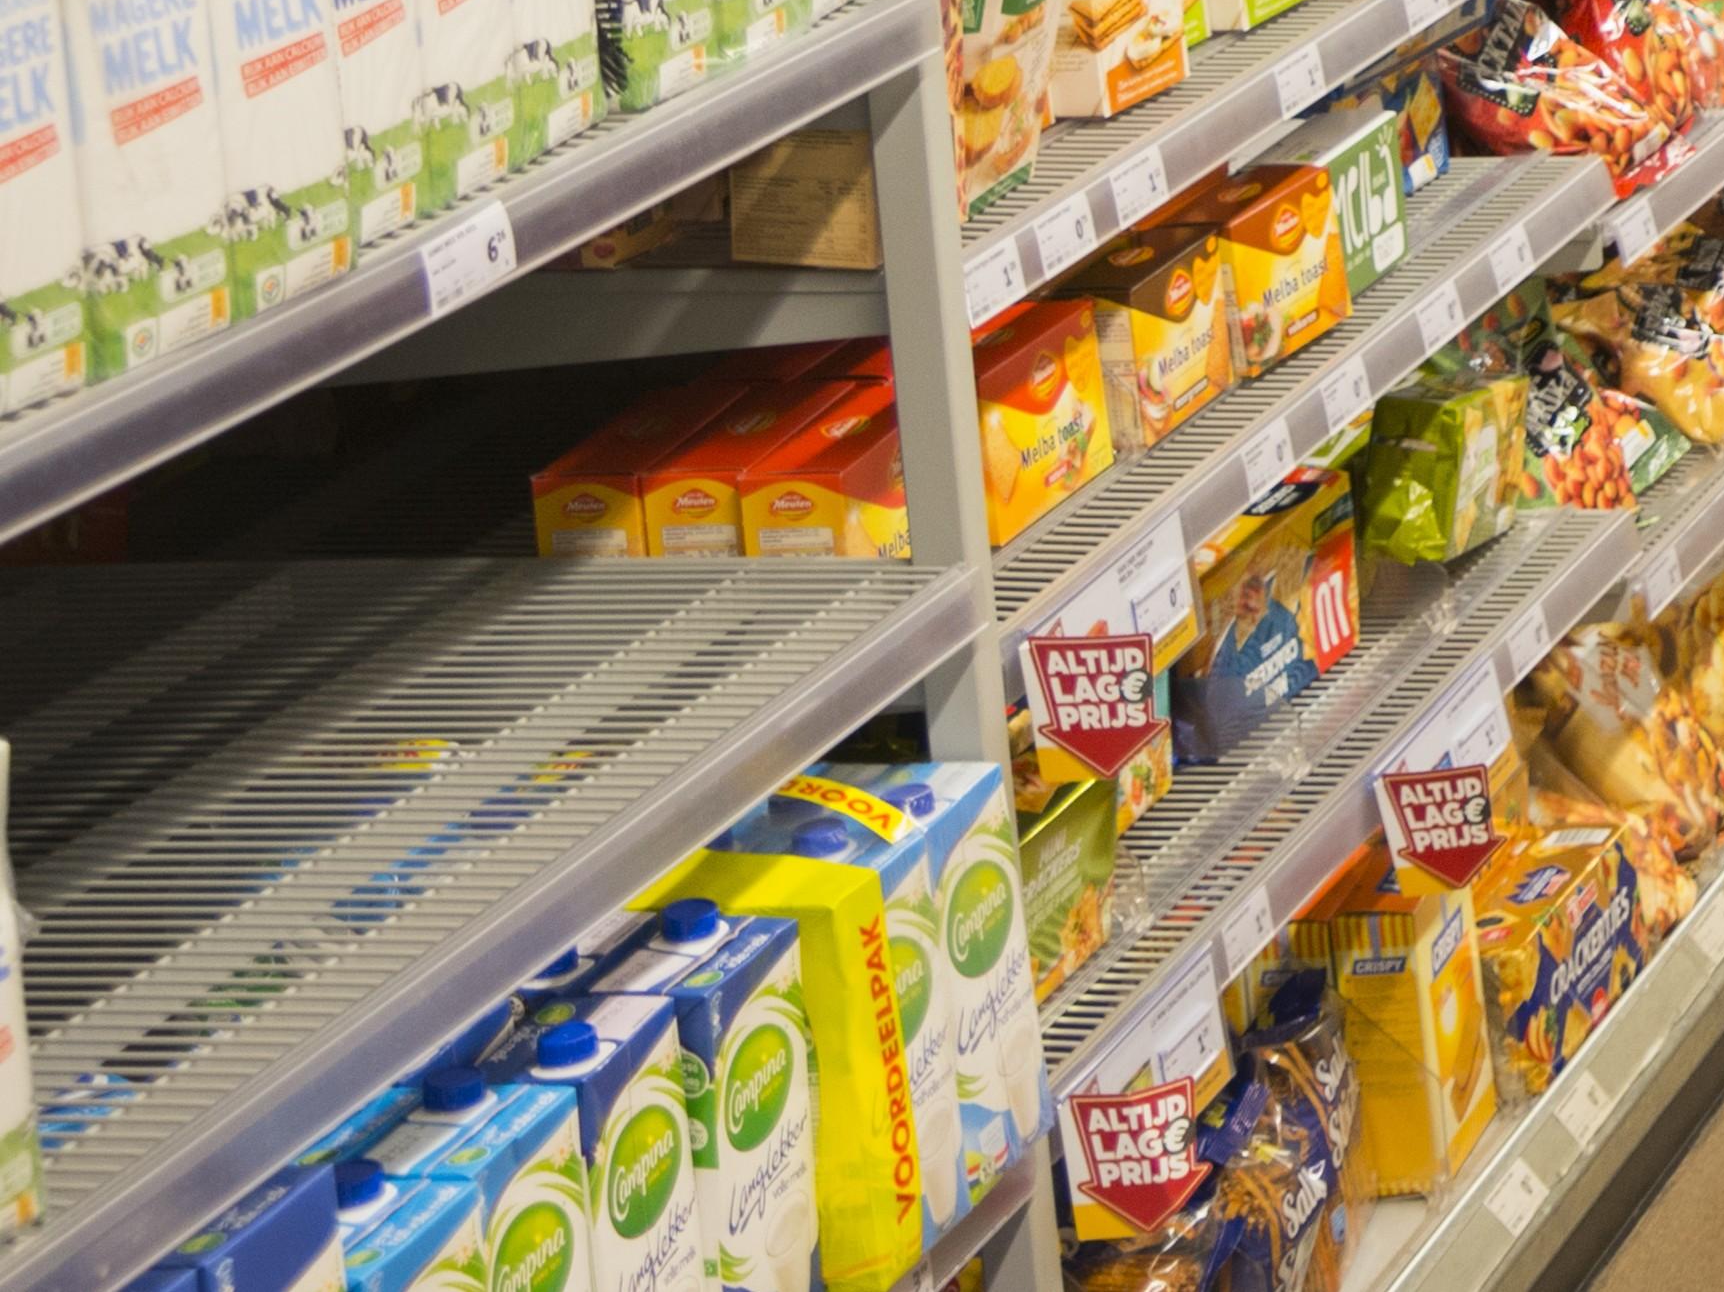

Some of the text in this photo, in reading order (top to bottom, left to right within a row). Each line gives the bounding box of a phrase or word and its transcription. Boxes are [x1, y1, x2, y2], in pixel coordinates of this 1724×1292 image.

[1264, 256, 1329, 309] Melba toast
[1022, 415, 1082, 471] Melba toast
[1047, 646, 1144, 676] ALTIJD
[1061, 704, 1147, 731] PRIJS
[1401, 778, 1485, 803] ALTIJD
[1413, 825, 1489, 851] PRIJS
[951, 879, 1013, 957] Campina
[1355, 960, 1403, 973] CRISPY
[859, 915, 912, 1226] VOORDEELPAK
[727, 1045, 793, 1136] Campina
[1088, 1100, 1187, 1134] ALTIJD
[612, 1127, 676, 1222] Campina
[1100, 1153, 1188, 1185] PRIJS
